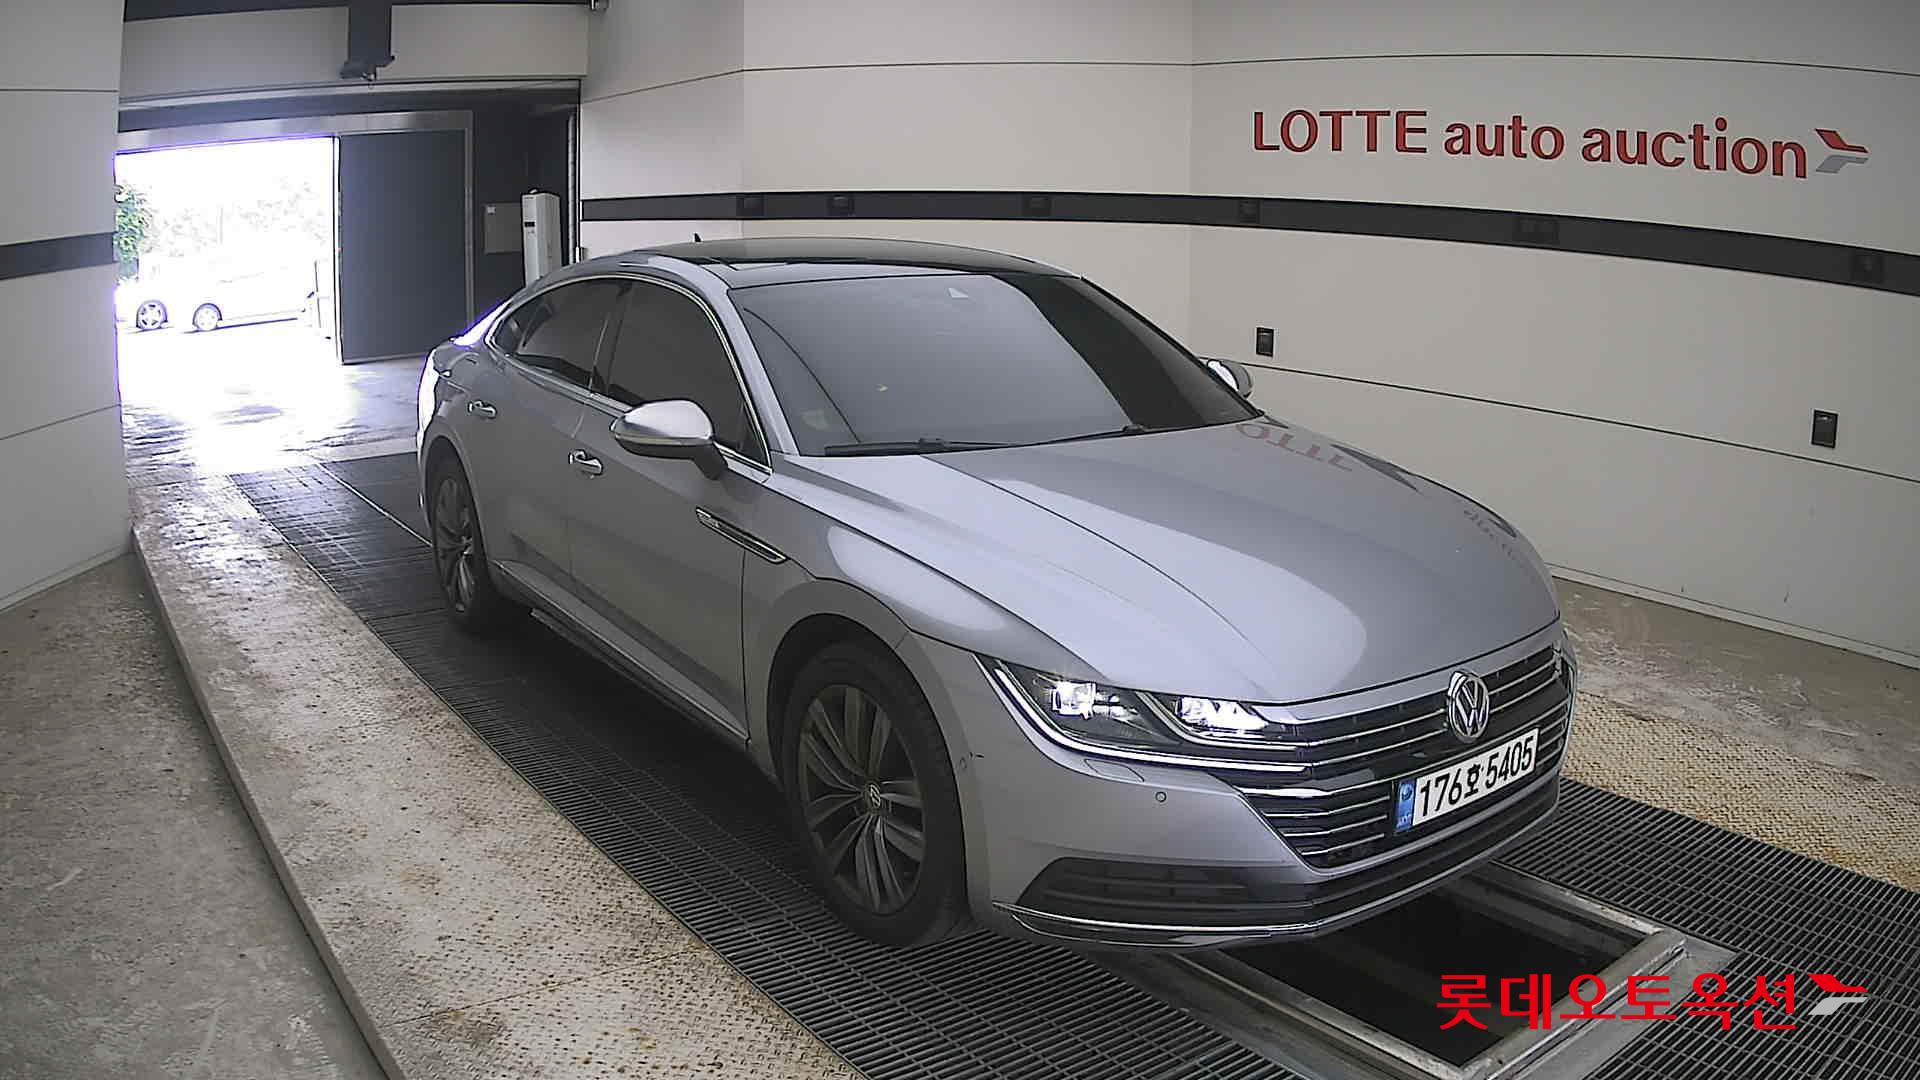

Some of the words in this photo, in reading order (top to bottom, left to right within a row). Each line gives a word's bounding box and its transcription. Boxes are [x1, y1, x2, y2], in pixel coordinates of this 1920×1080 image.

[1255, 110, 1427, 154] LOTTE
[1444, 115, 1565, 160] auto
[1582, 118, 1808, 178] auction
